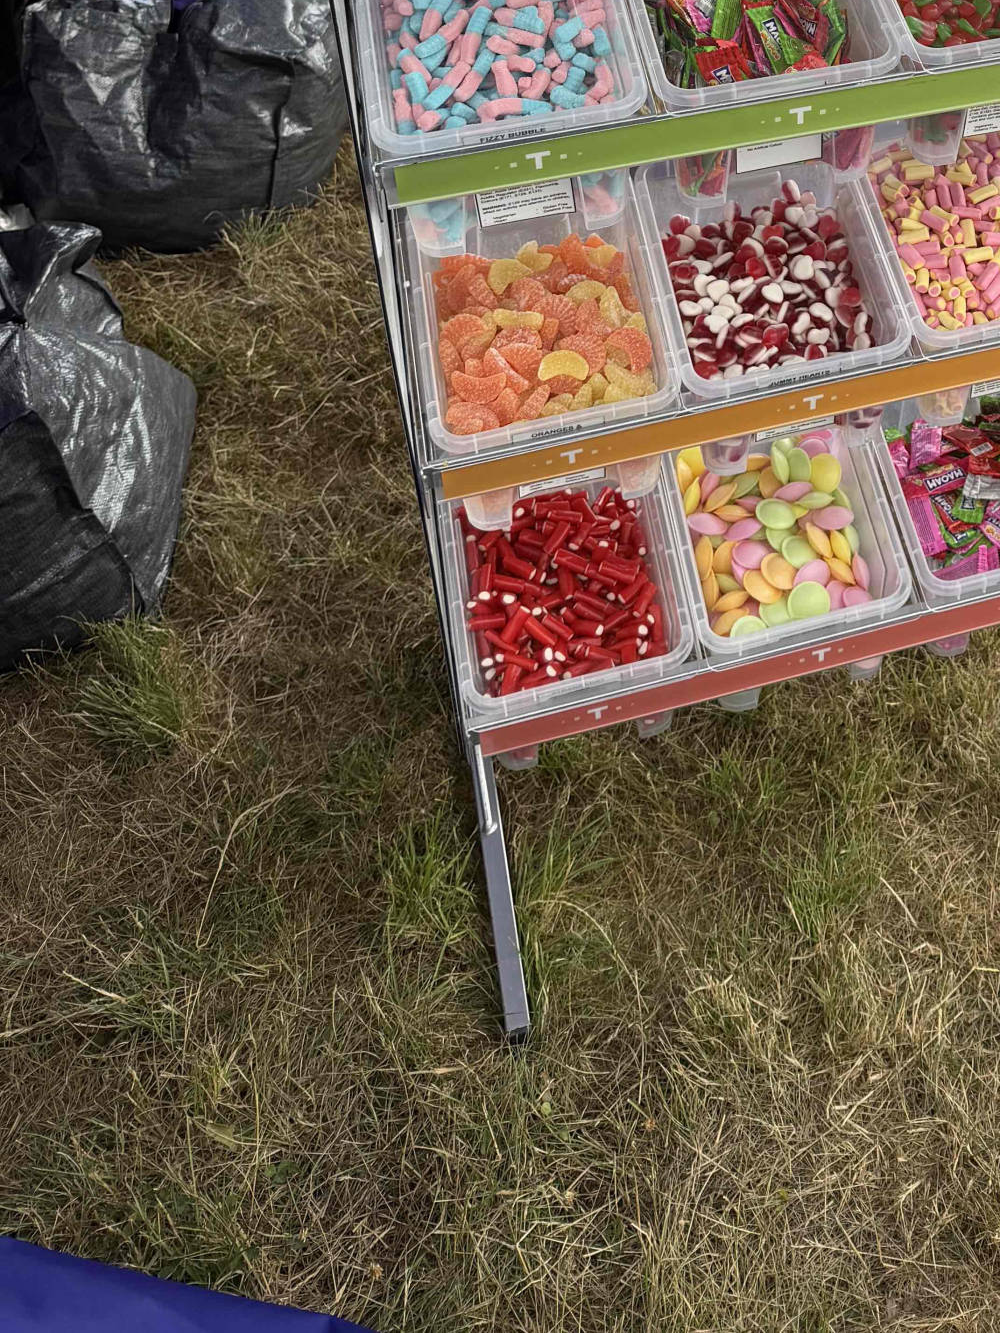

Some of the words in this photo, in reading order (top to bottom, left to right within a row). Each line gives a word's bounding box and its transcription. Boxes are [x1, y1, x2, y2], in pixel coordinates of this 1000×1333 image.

[788, 106, 811, 125] T
[480, 134, 506, 144] FIZZY
[508, 128, 546, 139] BUBBLE
[525, 150, 551, 170] T
[531, 425, 574, 438] ORANGES
[926, 468, 966, 490] MAOAM
